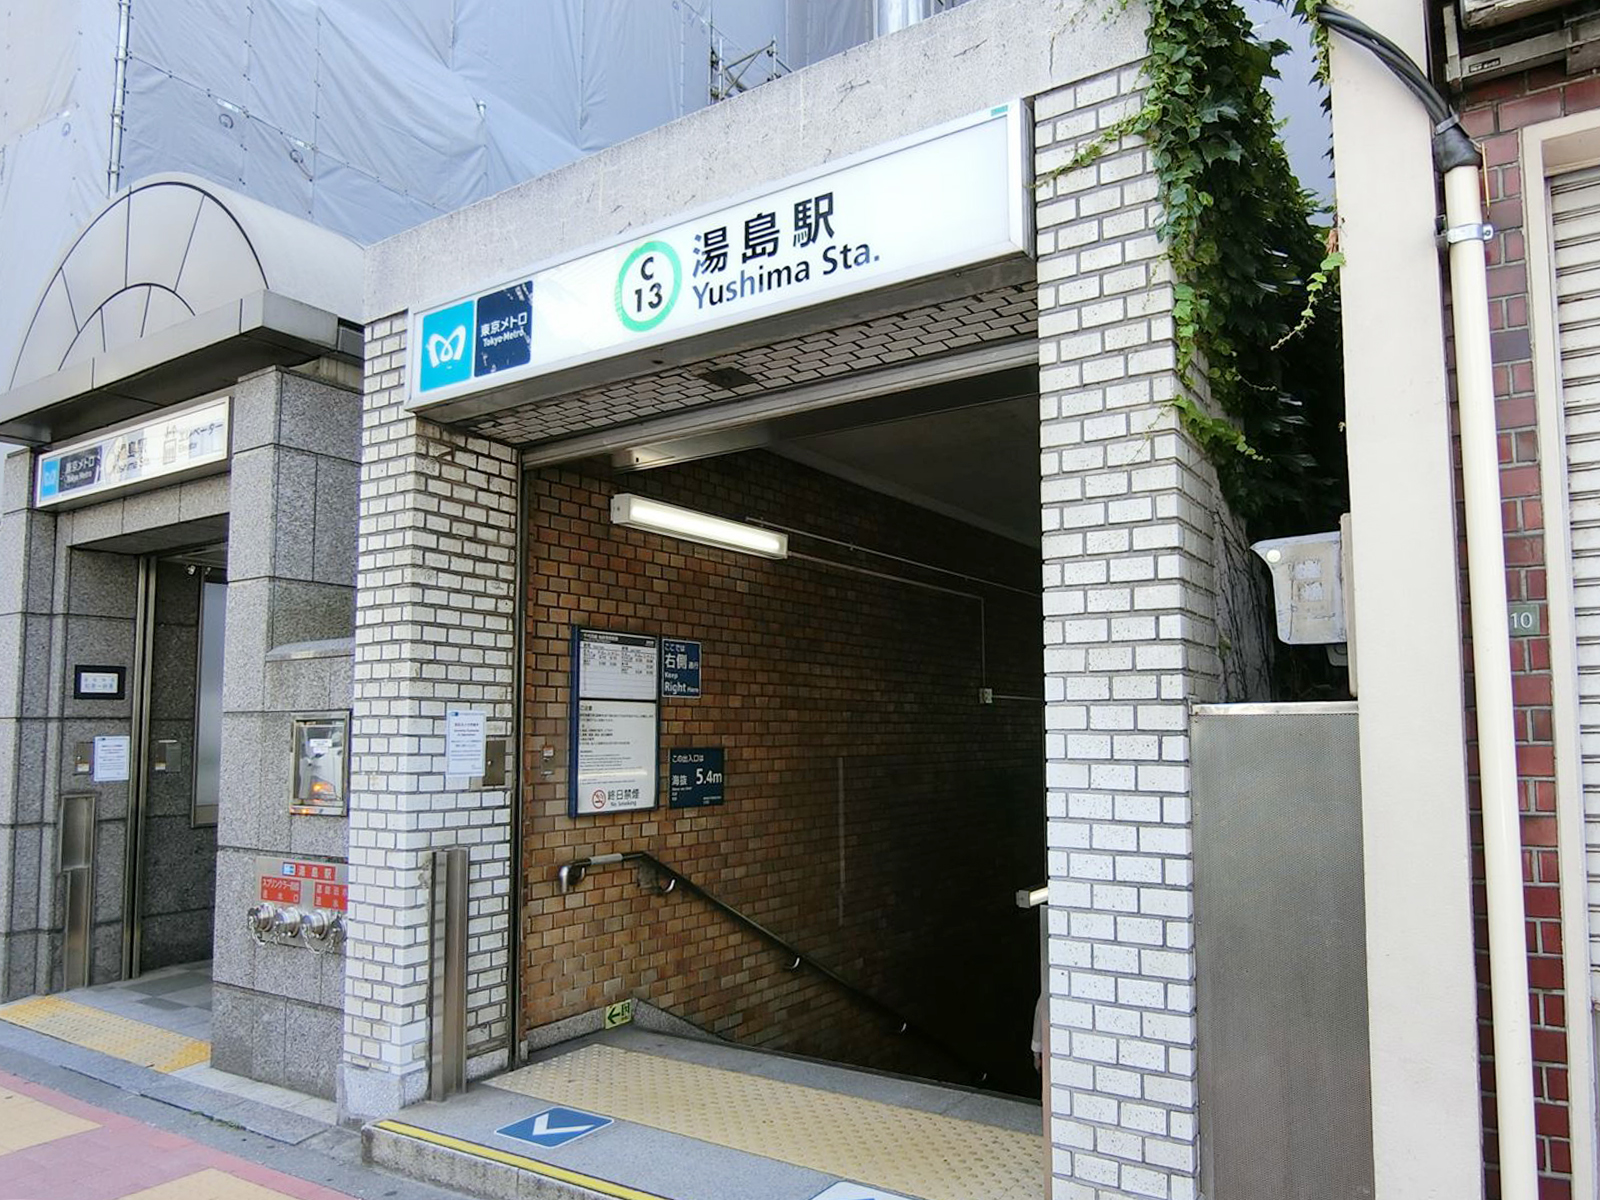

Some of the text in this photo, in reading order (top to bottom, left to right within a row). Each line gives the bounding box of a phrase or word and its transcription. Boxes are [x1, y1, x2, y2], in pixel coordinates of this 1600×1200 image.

[692, 192, 836, 278] 湯島駅
[640, 256, 655, 281] C
[693, 243, 881, 311] Yushima Sta.
[632, 289, 664, 315] 13
[480, 312, 528, 338] 東京メトロ
[1510, 611, 1533, 629] 10
[664, 681, 687, 695] Right
[695, 767, 723, 785] 5.4m
